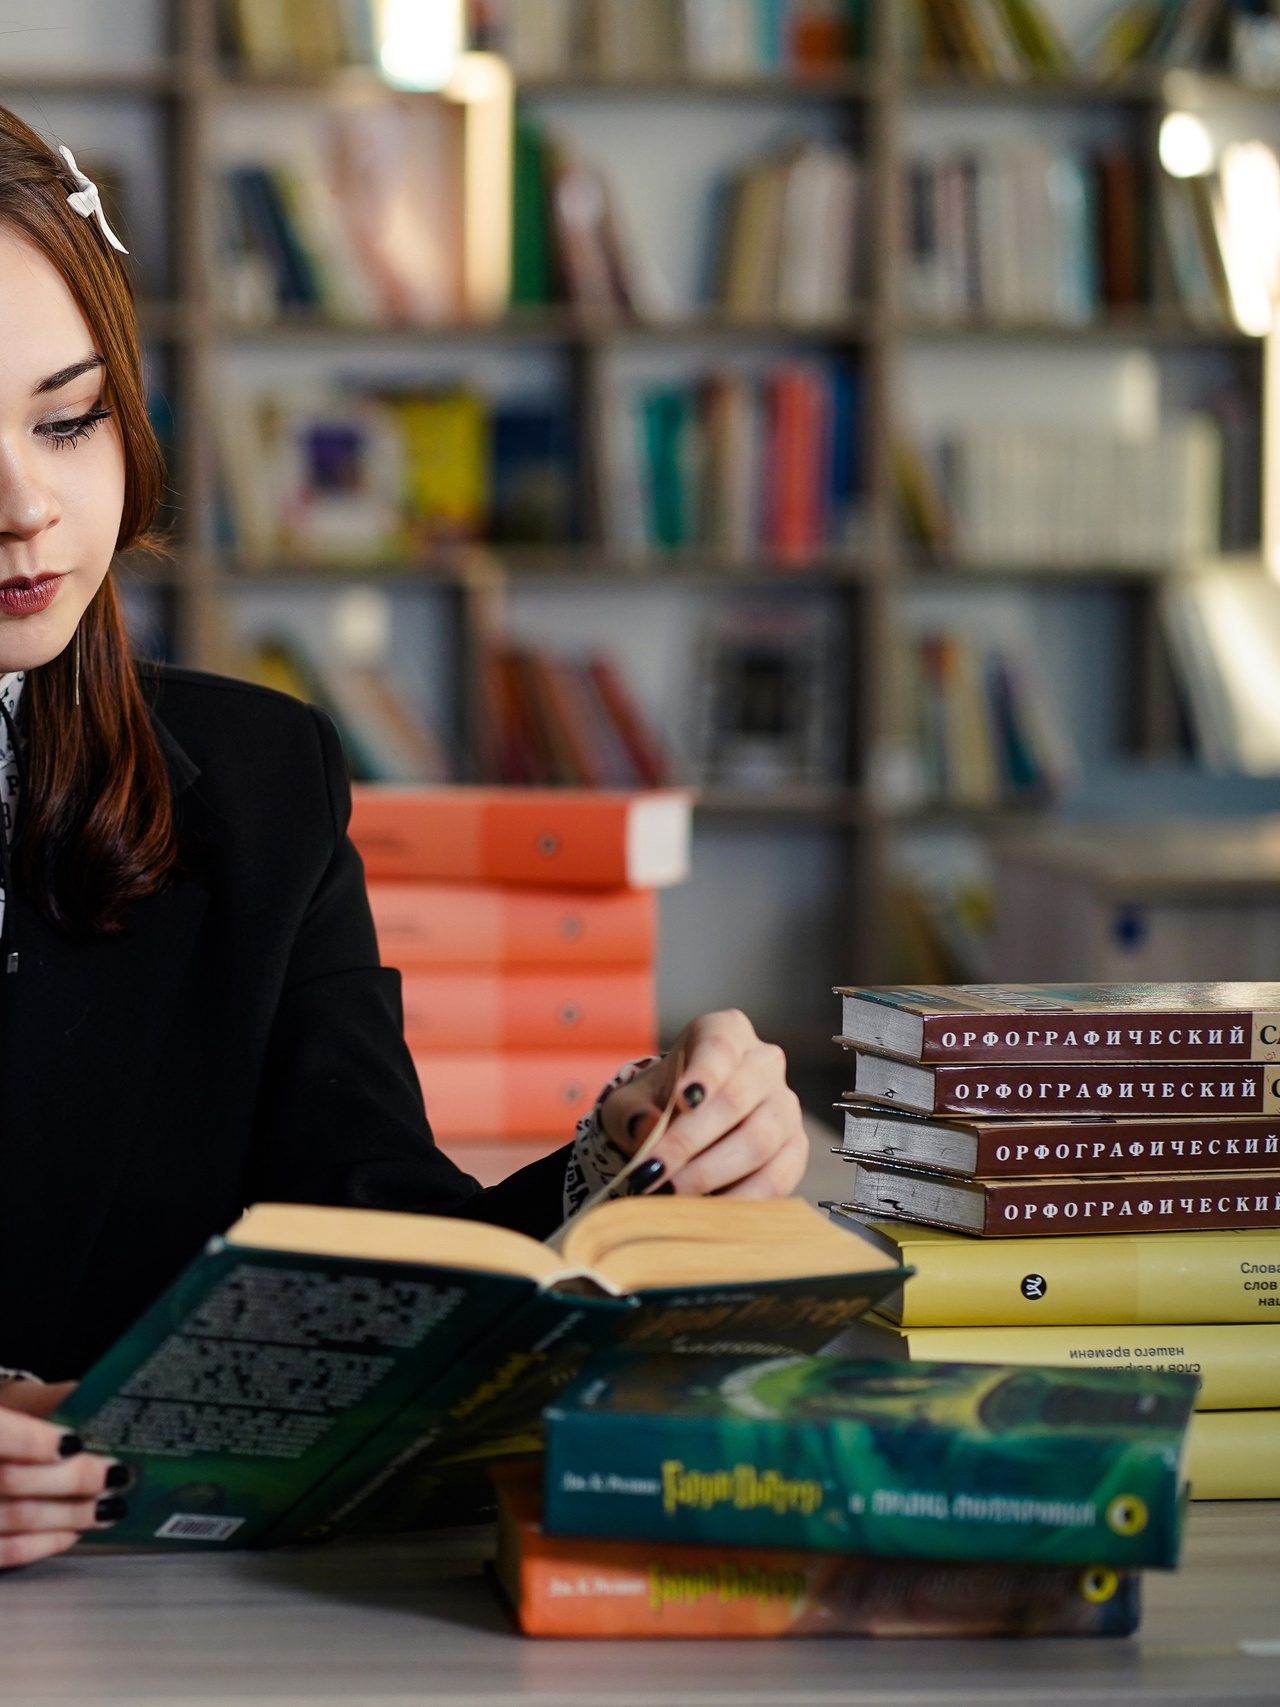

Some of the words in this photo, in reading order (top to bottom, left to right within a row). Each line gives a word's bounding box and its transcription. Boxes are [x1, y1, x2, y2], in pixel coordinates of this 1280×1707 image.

[941, 1025, 1245, 1048] ОРФОГРАФИЧЕСКИЙ
[955, 1078, 1257, 1100] ОРФОГРАФИЧЕСКИЙ
[996, 1134, 1279, 1161] ОРФОГРАФИЧЕСКИЙ
[1243, 1281, 1277, 1291] слов
[1069, 1346, 1131, 1359] времени
[1134, 1347, 1185, 1358] нашего
